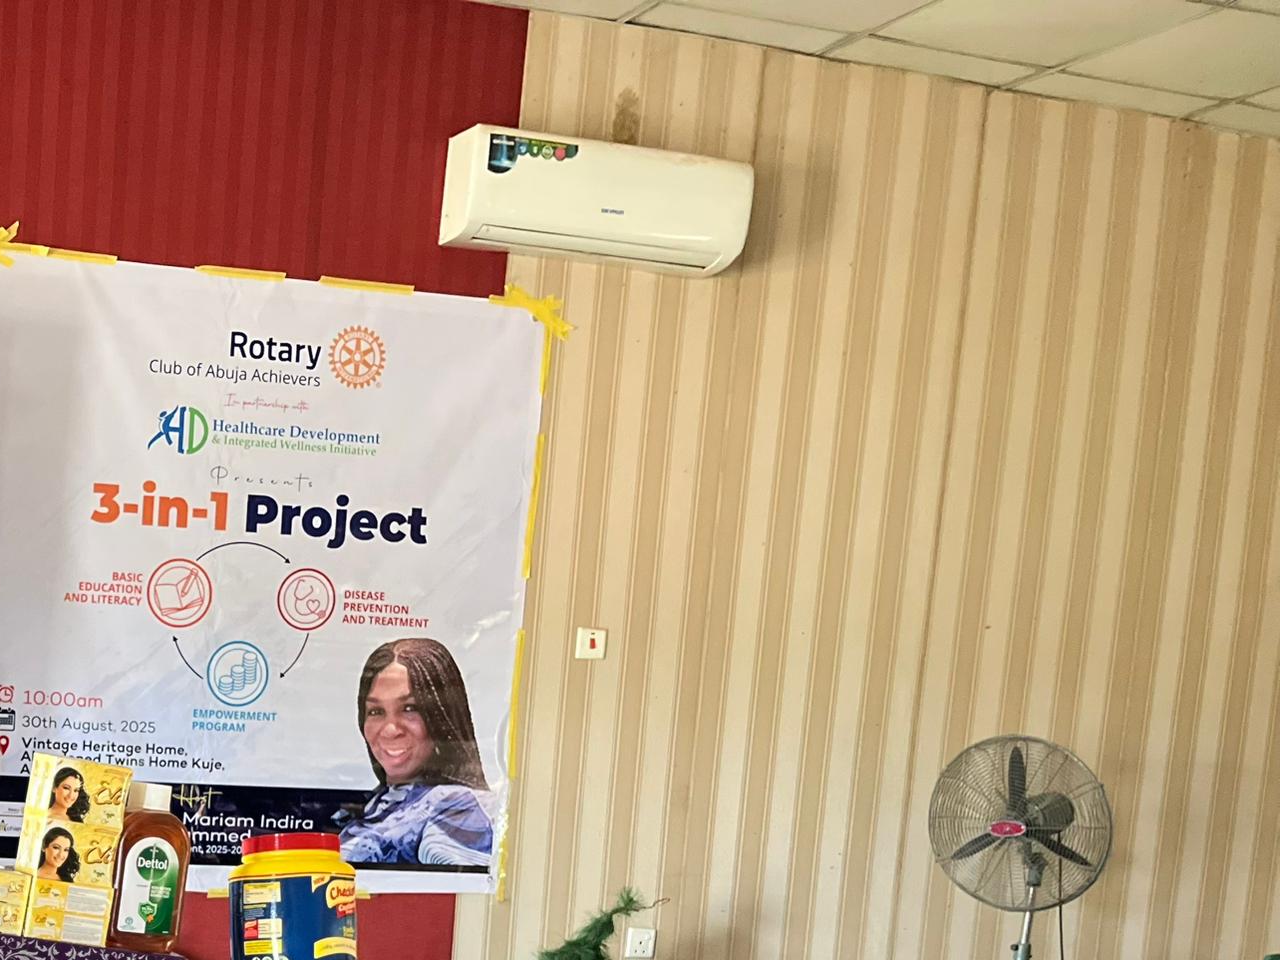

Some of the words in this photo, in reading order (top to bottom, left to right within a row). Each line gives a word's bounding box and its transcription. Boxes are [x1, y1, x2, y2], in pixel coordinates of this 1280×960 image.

[230, 331, 322, 370] Rotary
[149, 359, 183, 376] Club
[187, 362, 202, 377] of
[206, 365, 247, 382] Abuja
[251, 369, 321, 387] Achievers
[212, 419, 285, 438] Healthcare
[290, 426, 380, 445] Development
[223, 436, 277, 451] Integrated
[280, 440, 327, 454] Wellness
[329, 445, 376, 456] Initiative
[90, 480, 228, 531] 3-in-1
[246, 494, 427, 549] Project
[112, 572, 143, 583] BASIC
[79, 582, 143, 594] EDUCATION
[344, 590, 385, 601] DISEASE
[64, 593, 88, 603] AND
[91, 594, 142, 606] LITERACY
[343, 603, 409, 614] PREVENTION
[343, 615, 366, 625] AND
[369, 616, 429, 628] TREATMENT
[22, 690, 104, 708] 10:00am
[193, 709, 277, 721] EMPOWERMENT
[22, 715, 57, 729] 30th
[62, 718, 116, 734] August,
[120, 720, 156, 734] 2025
[192, 721, 246, 732] PROGRAM
[22, 737, 78, 755] Vintage
[82, 741, 141, 755] Heritage
[146, 744, 187, 756] Home,
[106, 754, 144, 767] Twins
[148, 757, 187, 769] Home
[191, 758, 225, 772] Kuje,
[183, 812, 254, 827] Mariam
[261, 815, 314, 830] Indira
[138, 856, 169, 869] Dettol
